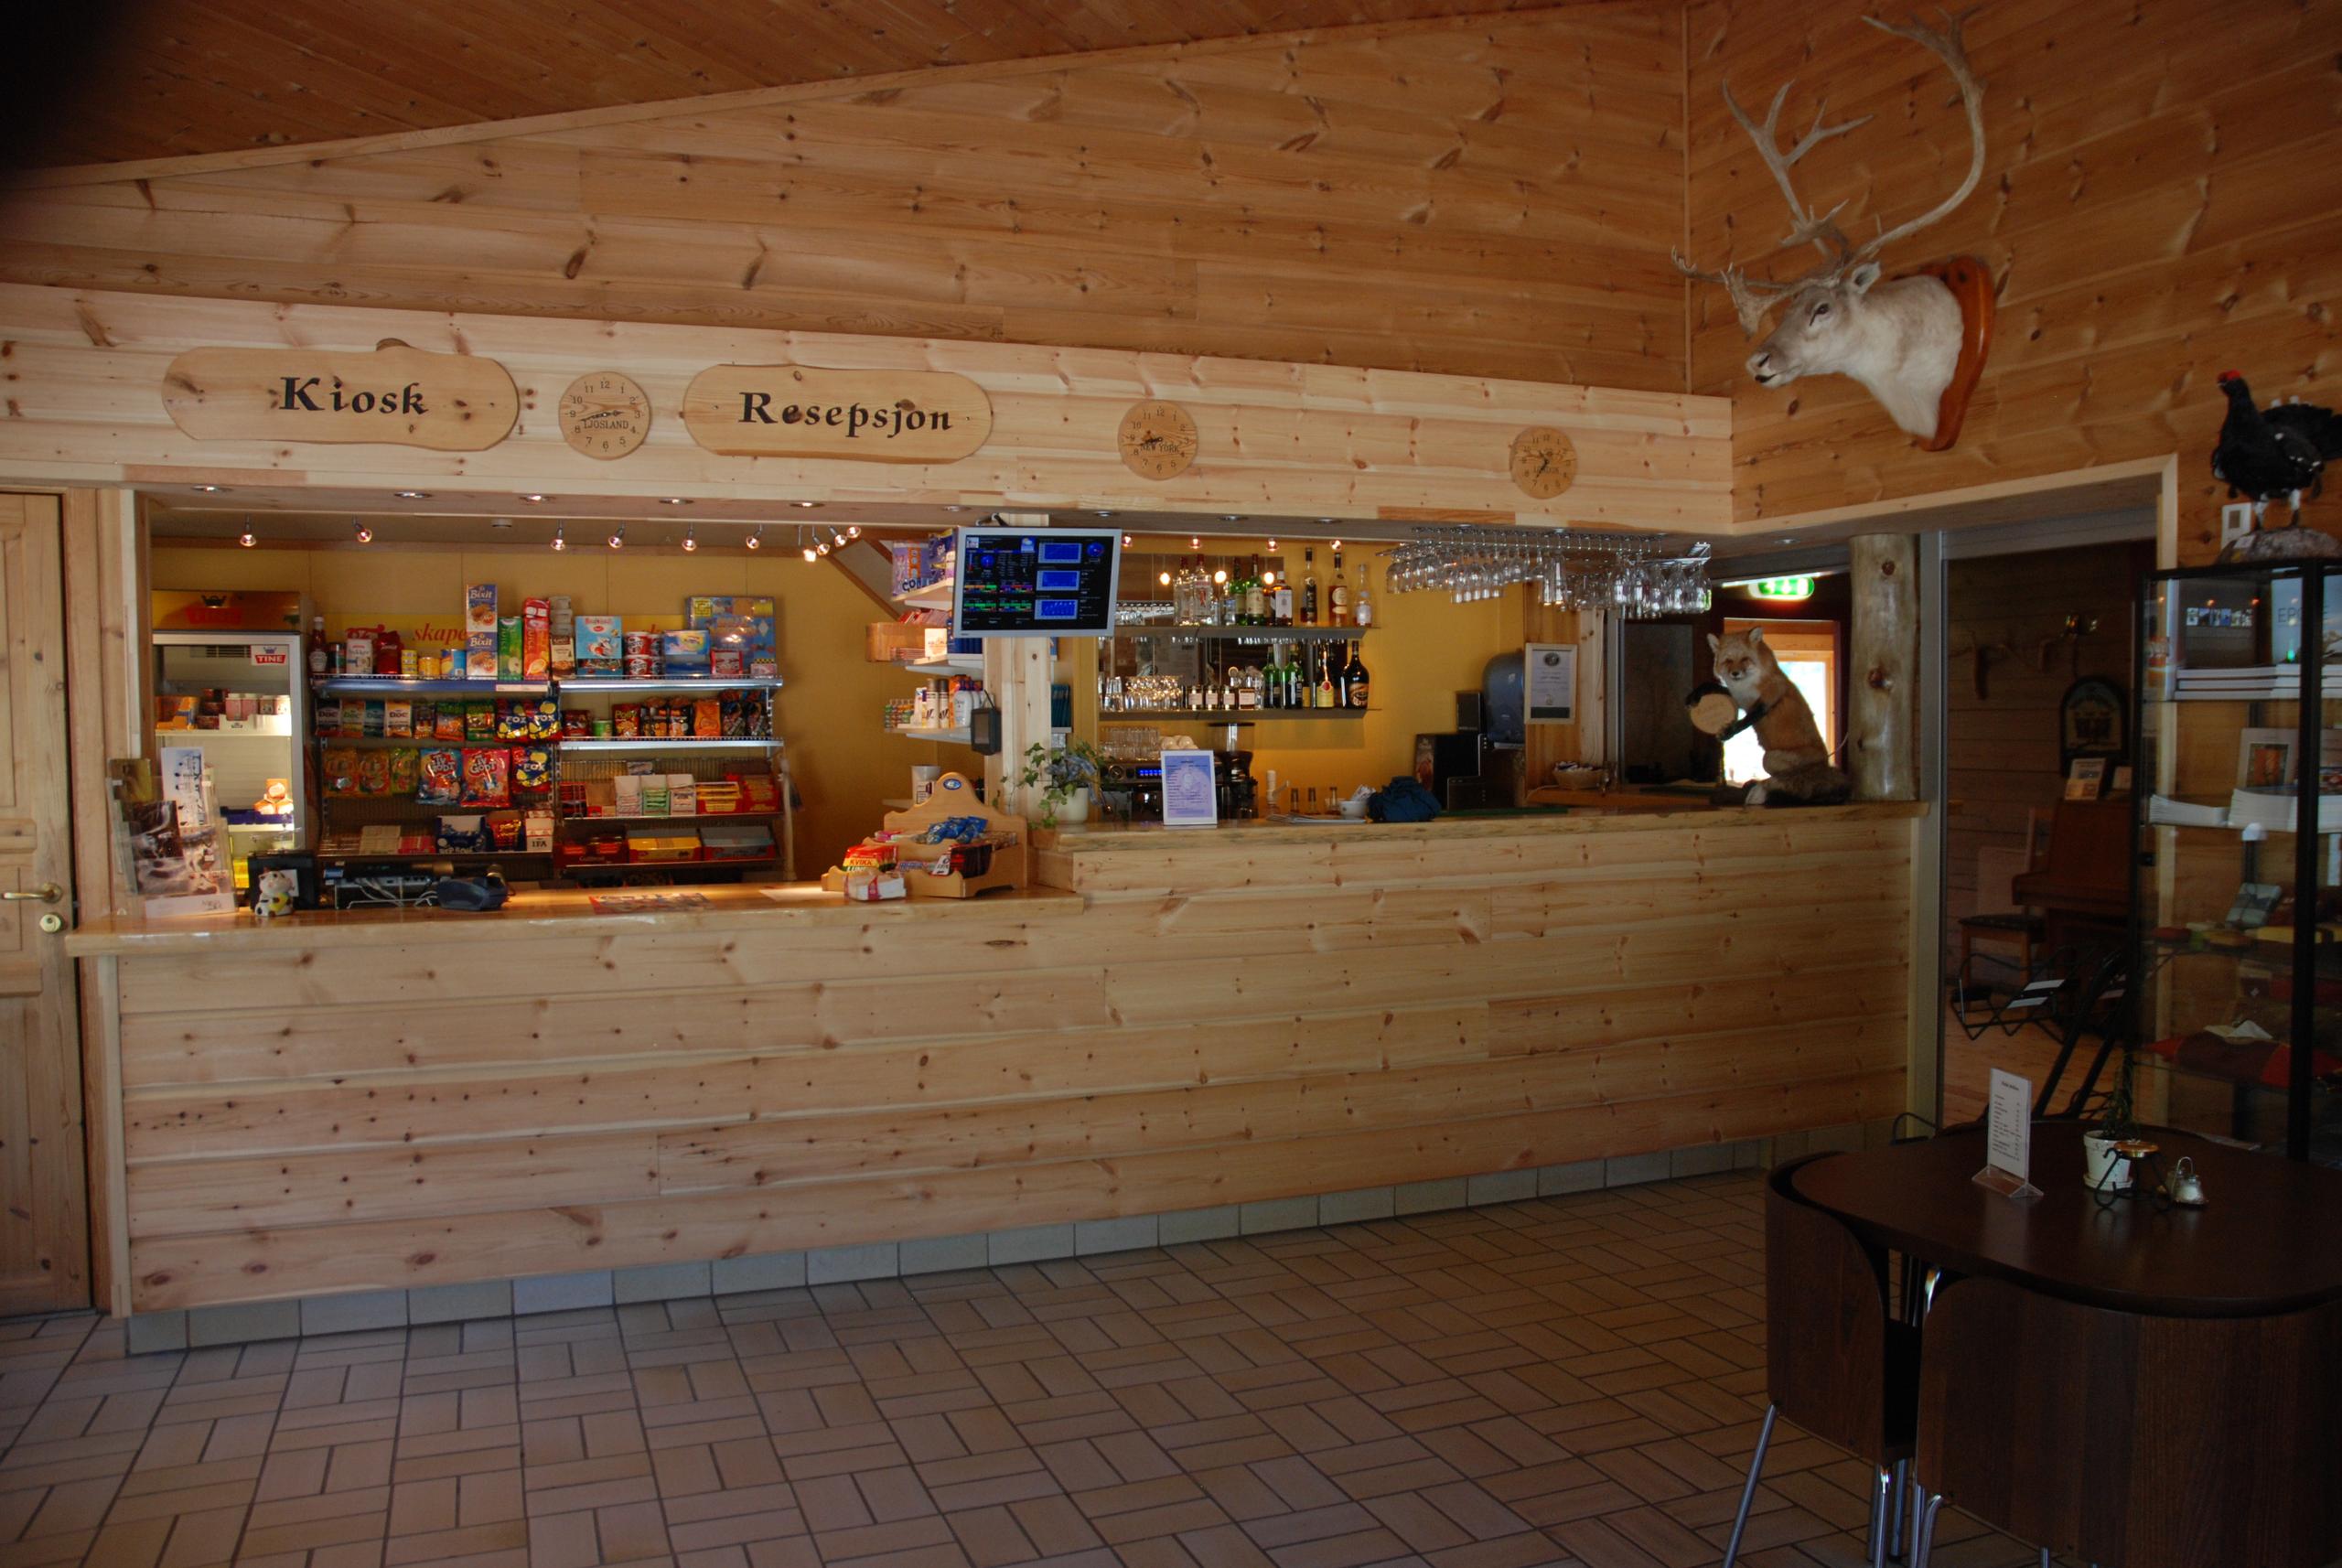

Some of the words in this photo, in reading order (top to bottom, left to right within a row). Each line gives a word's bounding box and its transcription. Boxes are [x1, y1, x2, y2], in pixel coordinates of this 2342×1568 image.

[586, 385, 594, 393] 11
[600, 381, 610, 389] 12
[620, 385, 625, 394] 1
[279, 375, 429, 415] Kiosk
[572, 396, 583, 404] 10
[629, 396, 636, 405] 2
[569, 410, 576, 418] 9
[634, 411, 640, 419] 3
[738, 391, 954, 439] Resepsjon
[575, 424, 581, 434] 8
[630, 425, 636, 434] 4
[586, 436, 592, 446] 7
[602, 441, 609, 450] 6
[619, 437, 626, 446] 5
[470, 589, 493, 599] Bixit
[470, 638, 493, 648] Bixit
[258, 655, 284, 663] TINE
